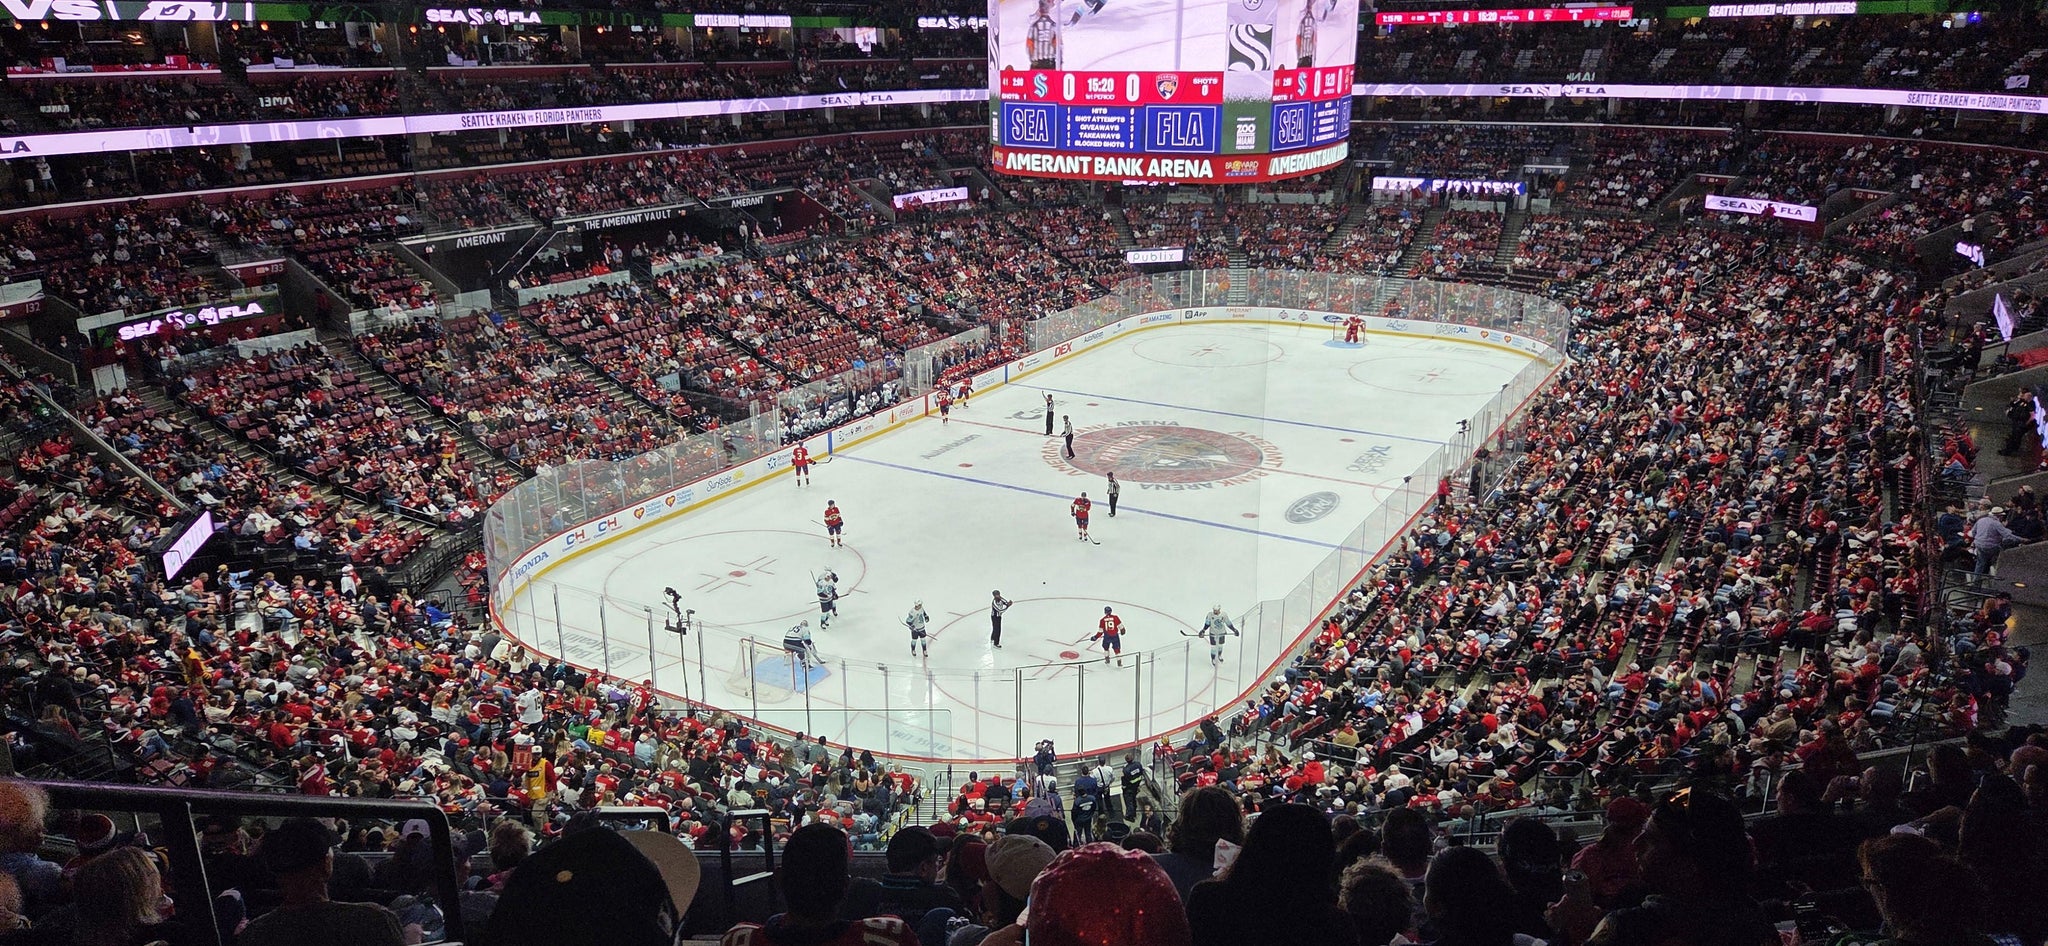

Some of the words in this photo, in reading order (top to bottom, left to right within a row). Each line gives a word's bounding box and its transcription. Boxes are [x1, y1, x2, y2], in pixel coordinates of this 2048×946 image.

[426, 9, 468, 22] SEA
[1709, 5, 1742, 17] SEATTLE
[1743, 4, 1776, 16] KRAKEN
[1783, 3, 1814, 15] FLORIDA
[1814, 2, 1857, 14] PANTHERS
[508, 11, 542, 23] FLA
[918, 17, 947, 28] SEA
[1062, 73, 1076, 101] 0
[1087, 78, 1115, 93] 15:20
[1126, 73, 1140, 102] 0
[1313, 70, 1321, 97] 0
[1500, 86, 1534, 95] SEA
[820, 96, 842, 105] SEA
[871, 94, 893, 102] FLA
[1907, 92, 1938, 105] SEATTLE
[1938, 94, 1969, 107] KRAKEN
[1977, 95, 2007, 109] FLORIDA
[2008, 97, 2042, 111] PANTHERS
[461, 112, 495, 128] SEATTLE
[496, 111, 527, 126] KRAKEN
[535, 110, 566, 124] FLORIDA
[567, 108, 602, 122] PANTHERS
[1011, 108, 1049, 142] SEA
[1091, 115, 1125, 123] ATTEMPTS
[1156, 112, 1204, 146] FLA
[1278, 109, 1304, 144] SEA
[1005, 152, 1092, 175] AMERANT
[1094, 156, 1143, 177] BANK
[1146, 158, 1213, 179] ARENA
[1268, 152, 1323, 177] AMERANT
[731, 196, 764, 207] AMERANT
[1720, 199, 1747, 209] SEA
[1780, 206, 1802, 216] FLA
[584, 219, 600, 230] THE
[601, 213, 642, 227] AMERANT
[643, 209, 672, 223] VAULT
[456, 233, 506, 249] AMERANT
[1132, 251, 1175, 262] Publix
[270, 263, 283, 272] 133
[26, 302, 41, 313] 132
[219, 303, 264, 320] FLA
[1148, 313, 1173, 322] AMAZING
[1456, 325, 1468, 334] XL
[1054, 341, 1073, 358] DEX
[1116, 419, 1180, 427] ARENA
[1139, 481, 1214, 491] ARENA
[598, 517, 618, 532] CH
[566, 529, 586, 546] CH
[514, 551, 549, 580] HONDA
[1104, 621, 1115, 631] 19
[630, 694, 641, 708] 28
